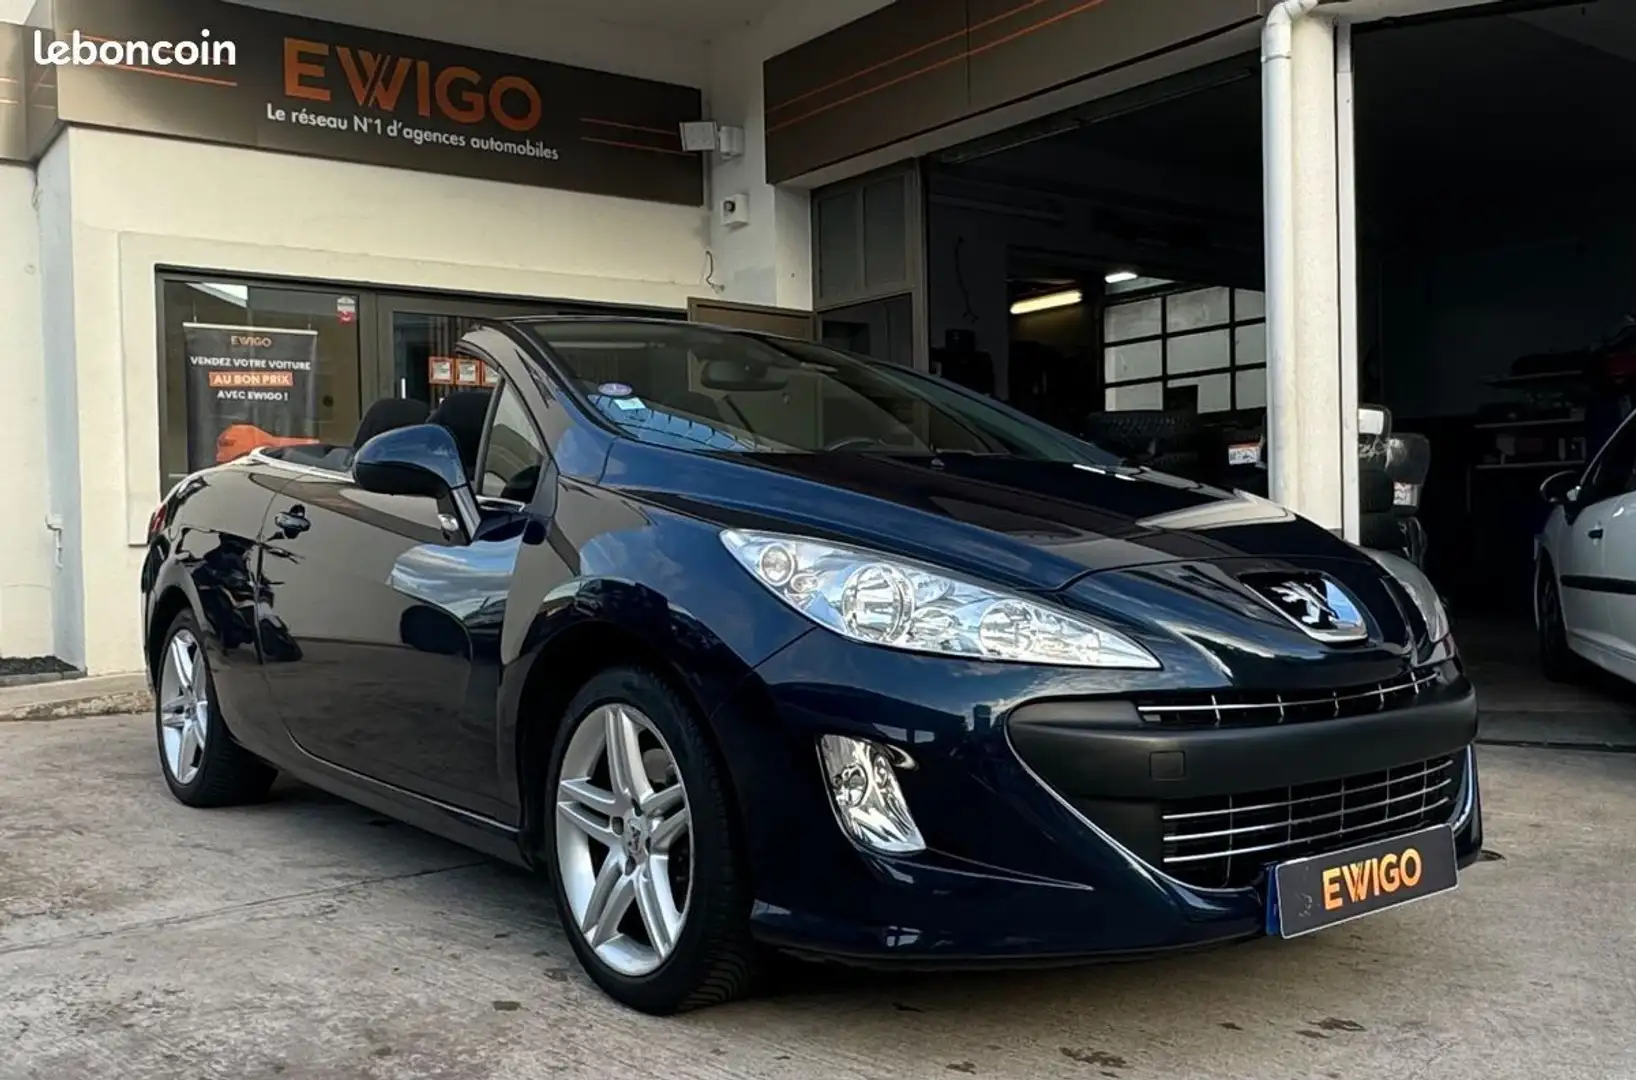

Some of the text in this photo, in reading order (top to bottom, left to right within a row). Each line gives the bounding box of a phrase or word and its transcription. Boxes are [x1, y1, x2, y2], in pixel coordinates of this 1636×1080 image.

[283, 36, 543, 132] EWIGO
[266, 104, 286, 121] Le
[291, 109, 348, 131] réseau
[470, 136, 559, 160] automobiles
[230, 335, 272, 348] EWIGO
[190, 356, 311, 371] VENDEZ VOTRE VOITURE
[214, 374, 290, 386] AU BON PRIX
[216, 390, 246, 400] AVEC
[247, 390, 283, 401] EWIGO
[1322, 848, 1422, 910] EWIGO
